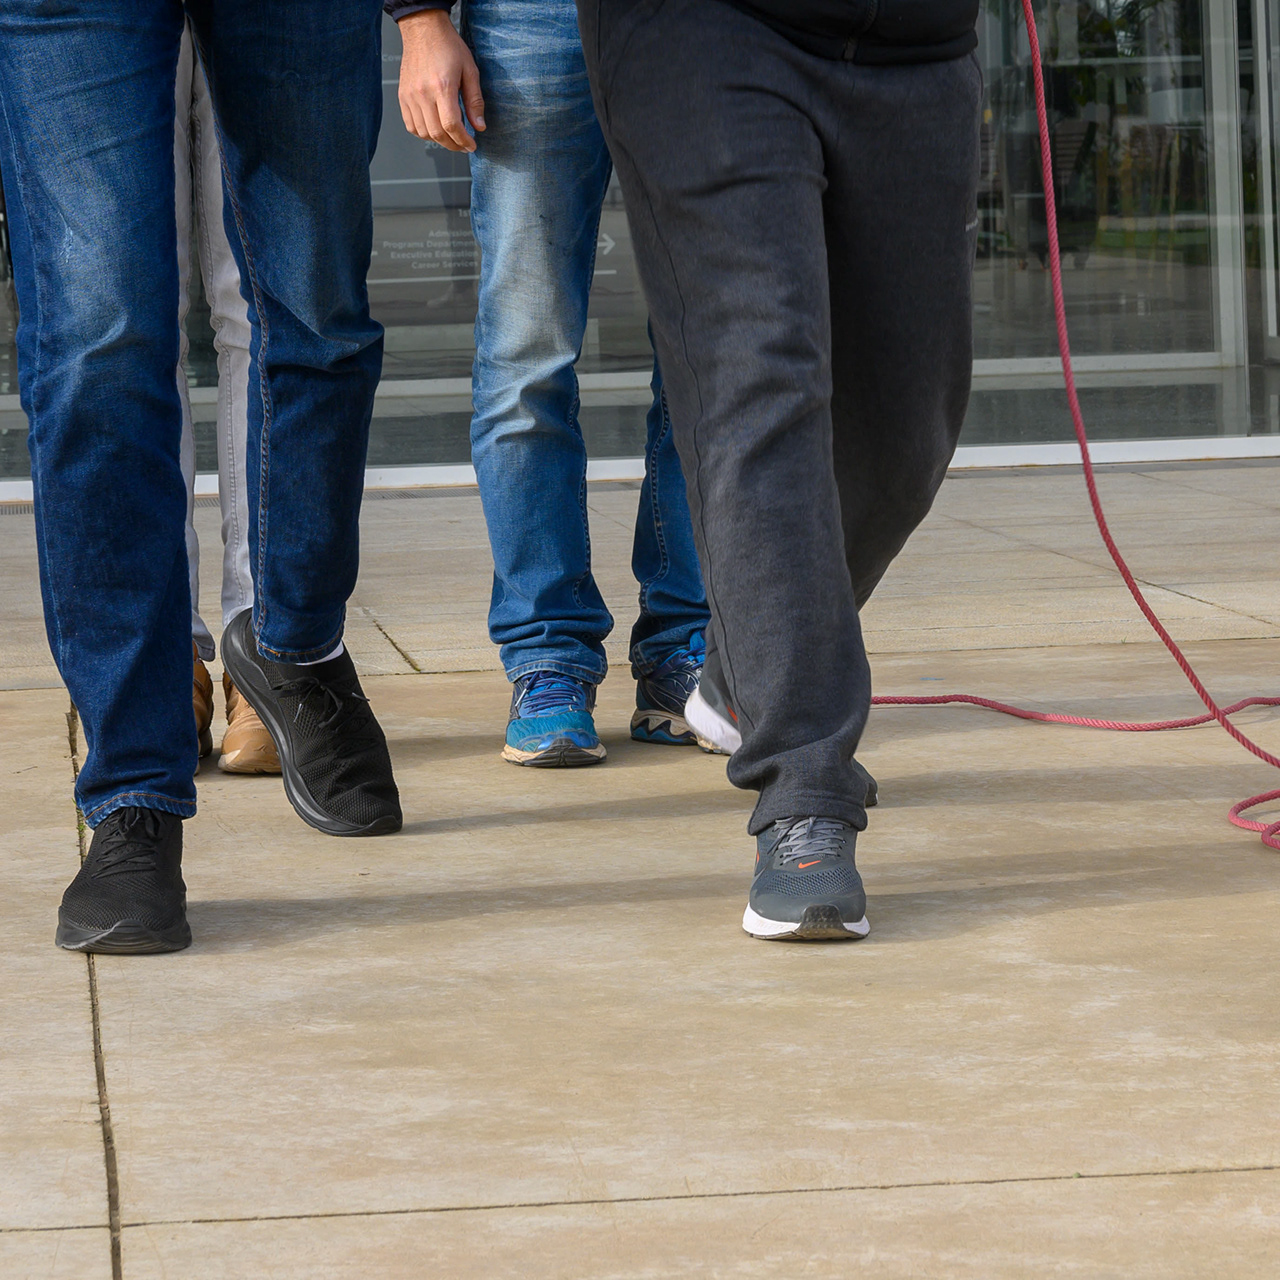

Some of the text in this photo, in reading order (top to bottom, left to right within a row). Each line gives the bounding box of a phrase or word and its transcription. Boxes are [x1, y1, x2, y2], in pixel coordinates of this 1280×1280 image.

[428, 230, 475, 238] Admission
[383, 241, 424, 250] Programs
[390, 250, 479, 260] Executive Education
[411, 260, 479, 269] Career Services
